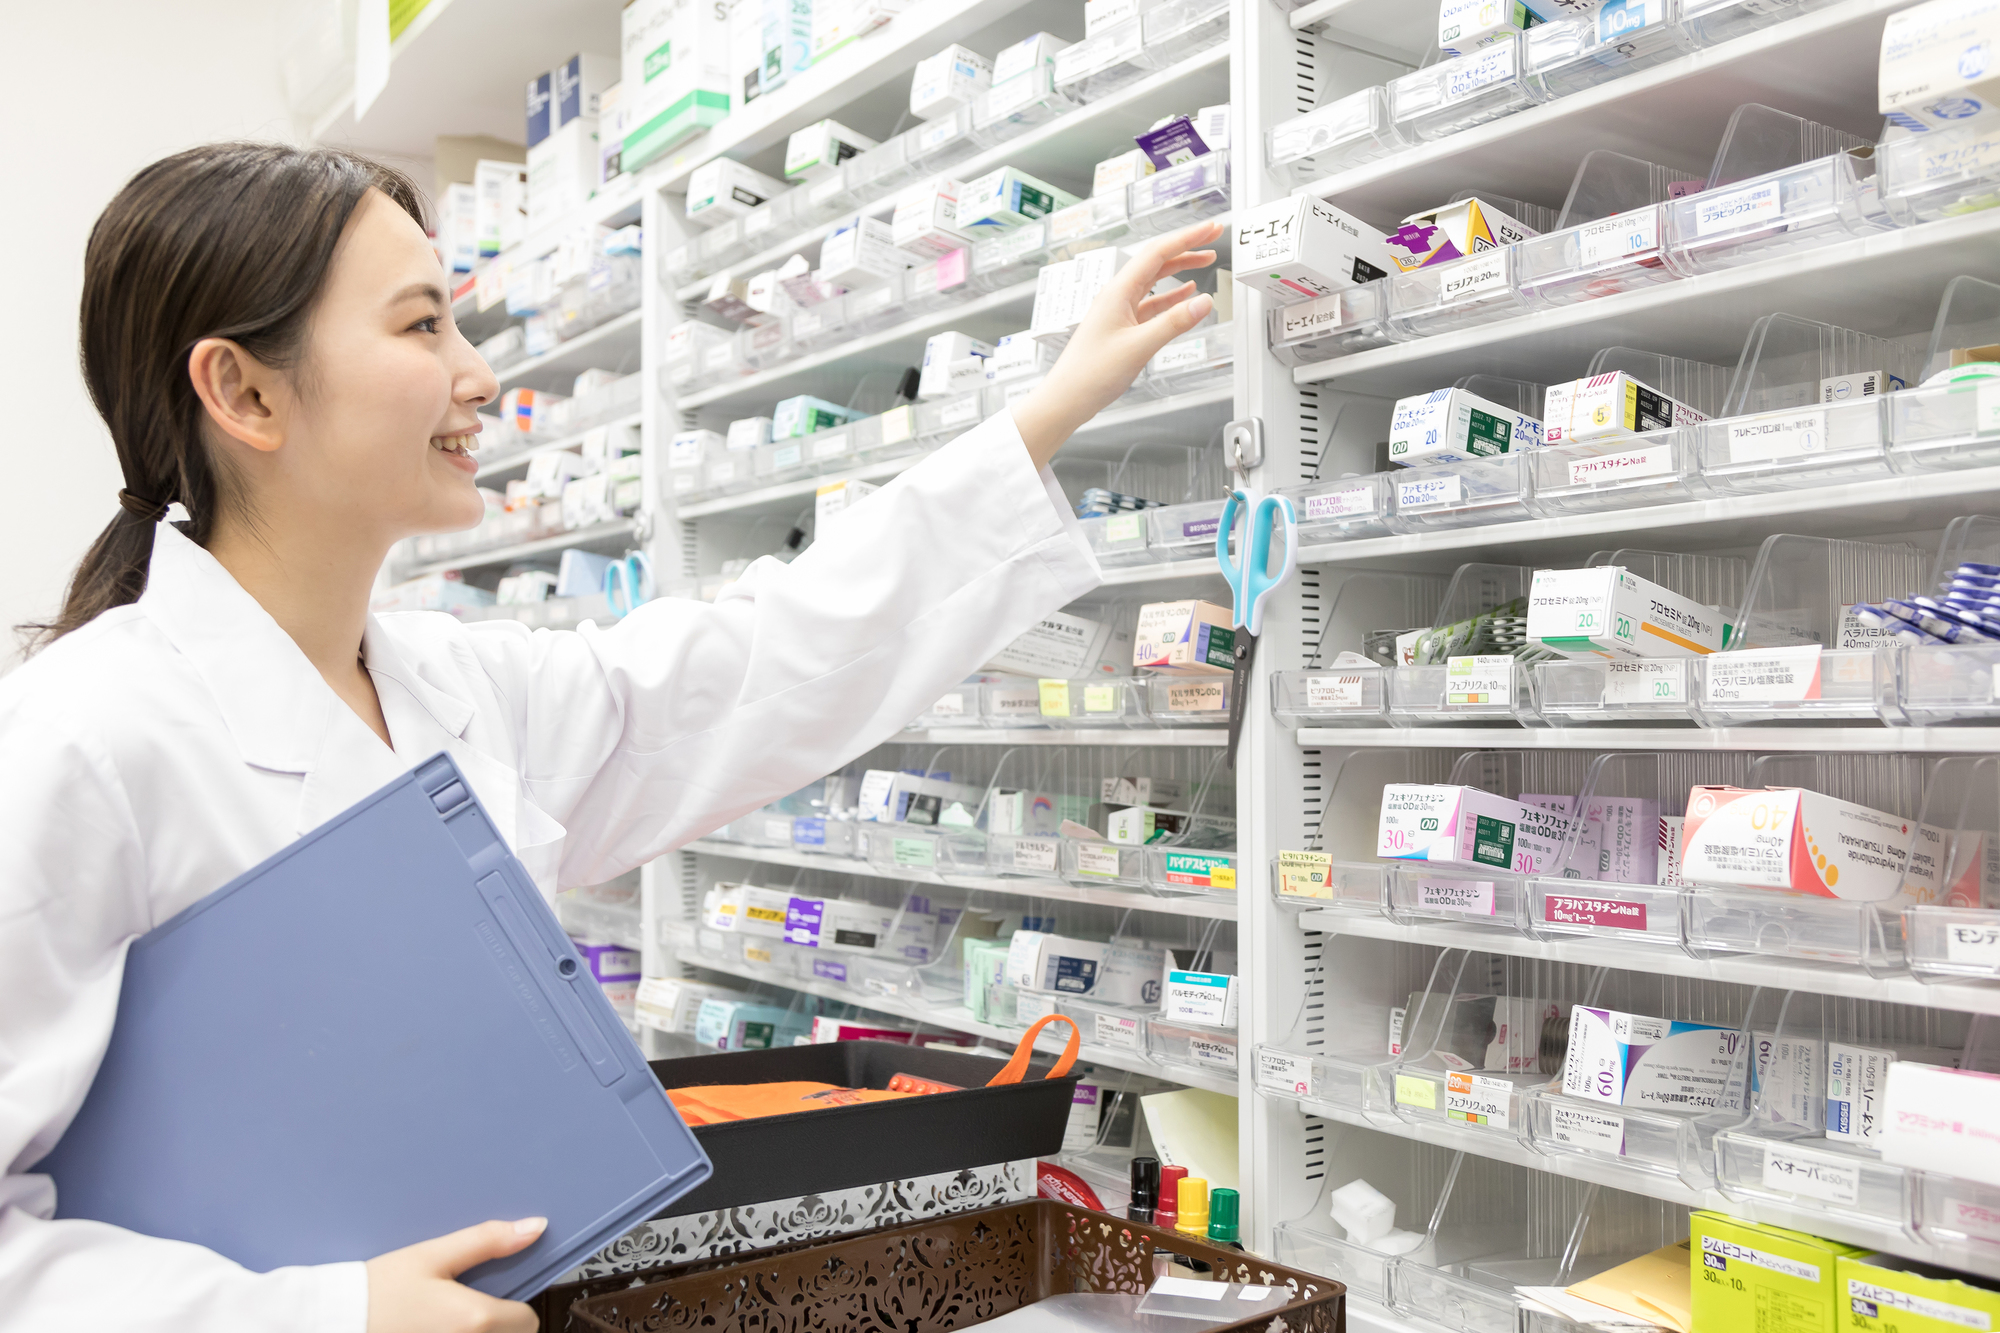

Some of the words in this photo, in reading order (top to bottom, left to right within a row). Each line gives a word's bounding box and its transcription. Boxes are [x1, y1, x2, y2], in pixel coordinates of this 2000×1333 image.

[1606, 10, 1641, 35] 10mg
[1451, 60, 1498, 83] ファモチジン
[1239, 214, 1295, 246] ビーエイ
[1501, 224, 1524, 242] ビラノア
[1297, 276, 1331, 294] ビーエ
[1446, 271, 1500, 292] ビラノア錠20mg
[1286, 310, 1336, 331] ビーエイ配合錠
[1396, 405, 1436, 420] ファモチジン
[1392, 440, 1408, 454] OD
[1573, 455, 1647, 474] プラバスタチンNa錠
[1401, 481, 1446, 495] ファモチジン
[1573, 475, 1587, 484] 5mg
[1401, 492, 1438, 505] OD錠20mg
[1649, 614, 1675, 632] FUROSEMIDE
[1675, 623, 1693, 638] TABLETS
[1650, 599, 1713, 637] フロセミド錠20mg「NP」
[1163, 632, 1175, 643] OD
[1616, 617, 1634, 642] 20mg
[1136, 643, 1158, 660] 40mg
[1609, 661, 1678, 674] フロセミド錠20mg「NP」
[1711, 673, 1795, 686] ベラパミル塩酸塩錠
[1171, 687, 1222, 698] バルサルタンOD錠
[1310, 687, 1345, 695] ビソプロロール
[1654, 682, 1676, 697] 20mg
[1712, 688, 1740, 699] 40mg
[1389, 792, 1446, 803] フェキソフェナジン
[1421, 818, 1438, 831] OD
[1384, 829, 1414, 850] 30mg
[1756, 835, 1784, 847] 40mg
[1703, 844, 1784, 858] ベラパミル塩酸塩錠
[1847, 849, 1896, 874] Hydrochloride
[1282, 874, 1298, 892] 1mg
[1311, 872, 1323, 882] OD
[1424, 886, 1481, 899] フェキソフェナジン
[1553, 897, 1640, 917] プラバスタチンNa錠
[1553, 909, 1596, 925] 10mg「トーワ」
[1261, 1054, 1295, 1068] ビソプロロール
[1832, 1052, 1845, 1077] 50mg
[1448, 1075, 1472, 1091] 20mg
[1597, 1060, 1616, 1097] 60mg
[1861, 1055, 1878, 1138] ベオーバ錠50mg
[1839, 1101, 1849, 1133] KISSEI
[1771, 1159, 1854, 1190] ベオーバ錠50mg
